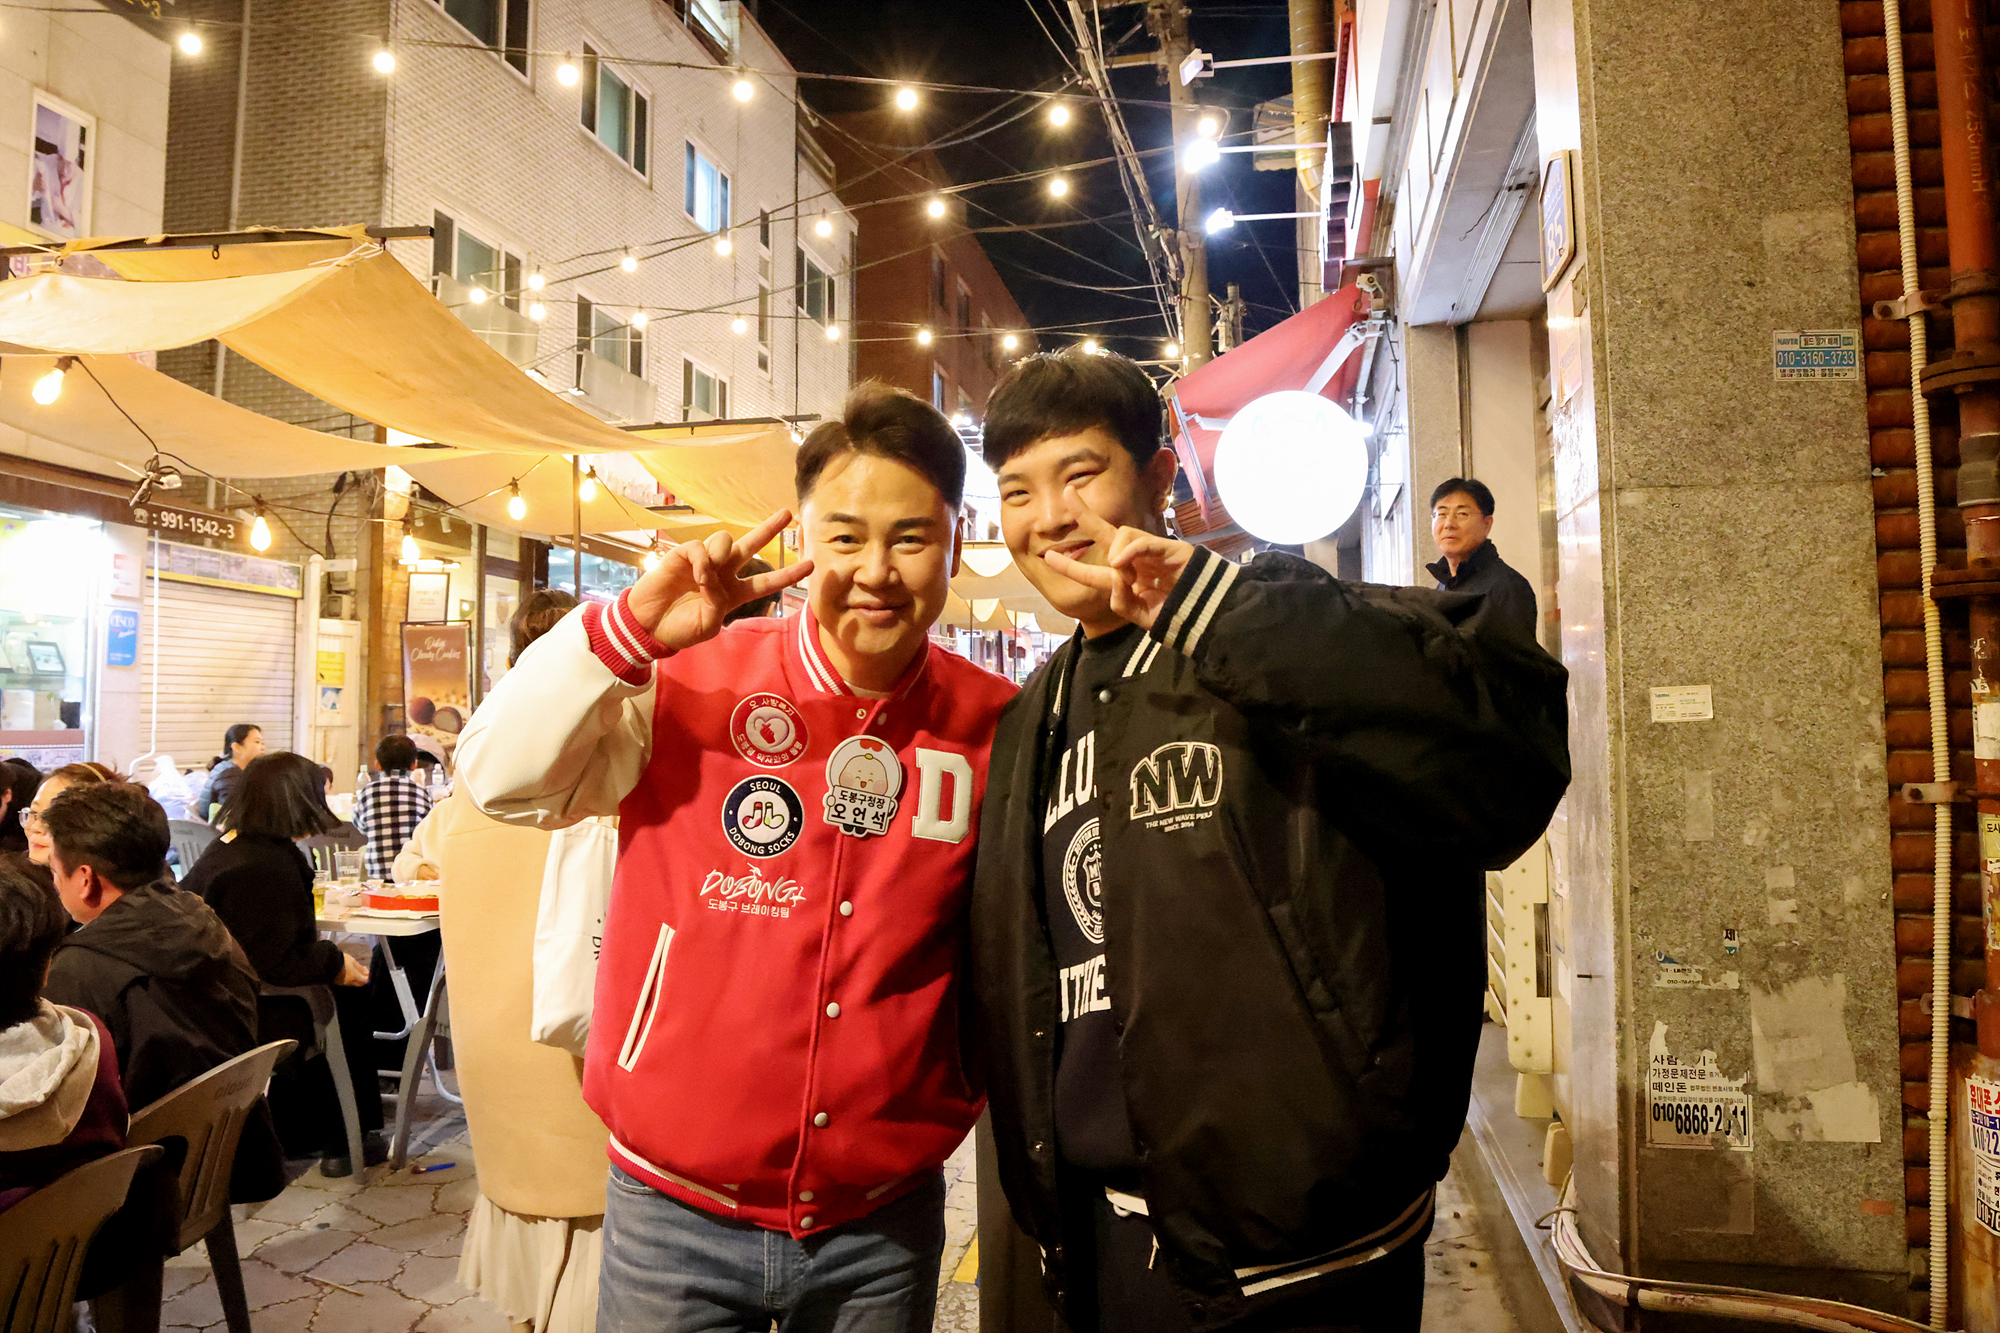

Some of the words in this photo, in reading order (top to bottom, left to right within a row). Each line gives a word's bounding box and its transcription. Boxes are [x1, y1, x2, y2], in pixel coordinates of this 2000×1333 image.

[1547, 207, 1564, 267] 85
[1777, 350, 1855, 366] 010-3160-3733
[160, 510, 236, 540] 991-1542~3
[756, 752, 790, 764] 약자와의
[749, 780, 781, 794] SEOUL
[1129, 741, 1223, 821] NW
[838, 789, 886, 810] 도봉구청장
[911, 747, 974, 845] D
[1145, 820, 1158, 829] THE
[1159, 817, 1173, 826] NEW
[1175, 813, 1195, 822] WAVE
[728, 826, 765, 855] DOBONG
[767, 831, 796, 854] SOCKS
[708, 898, 739, 912] 도봉구
[1652, 1068, 1706, 1080] 가정문제전문
[1652, 1081, 1687, 1093] 떼인돈
[1970, 1084, 1993, 1115] 휴대폰
